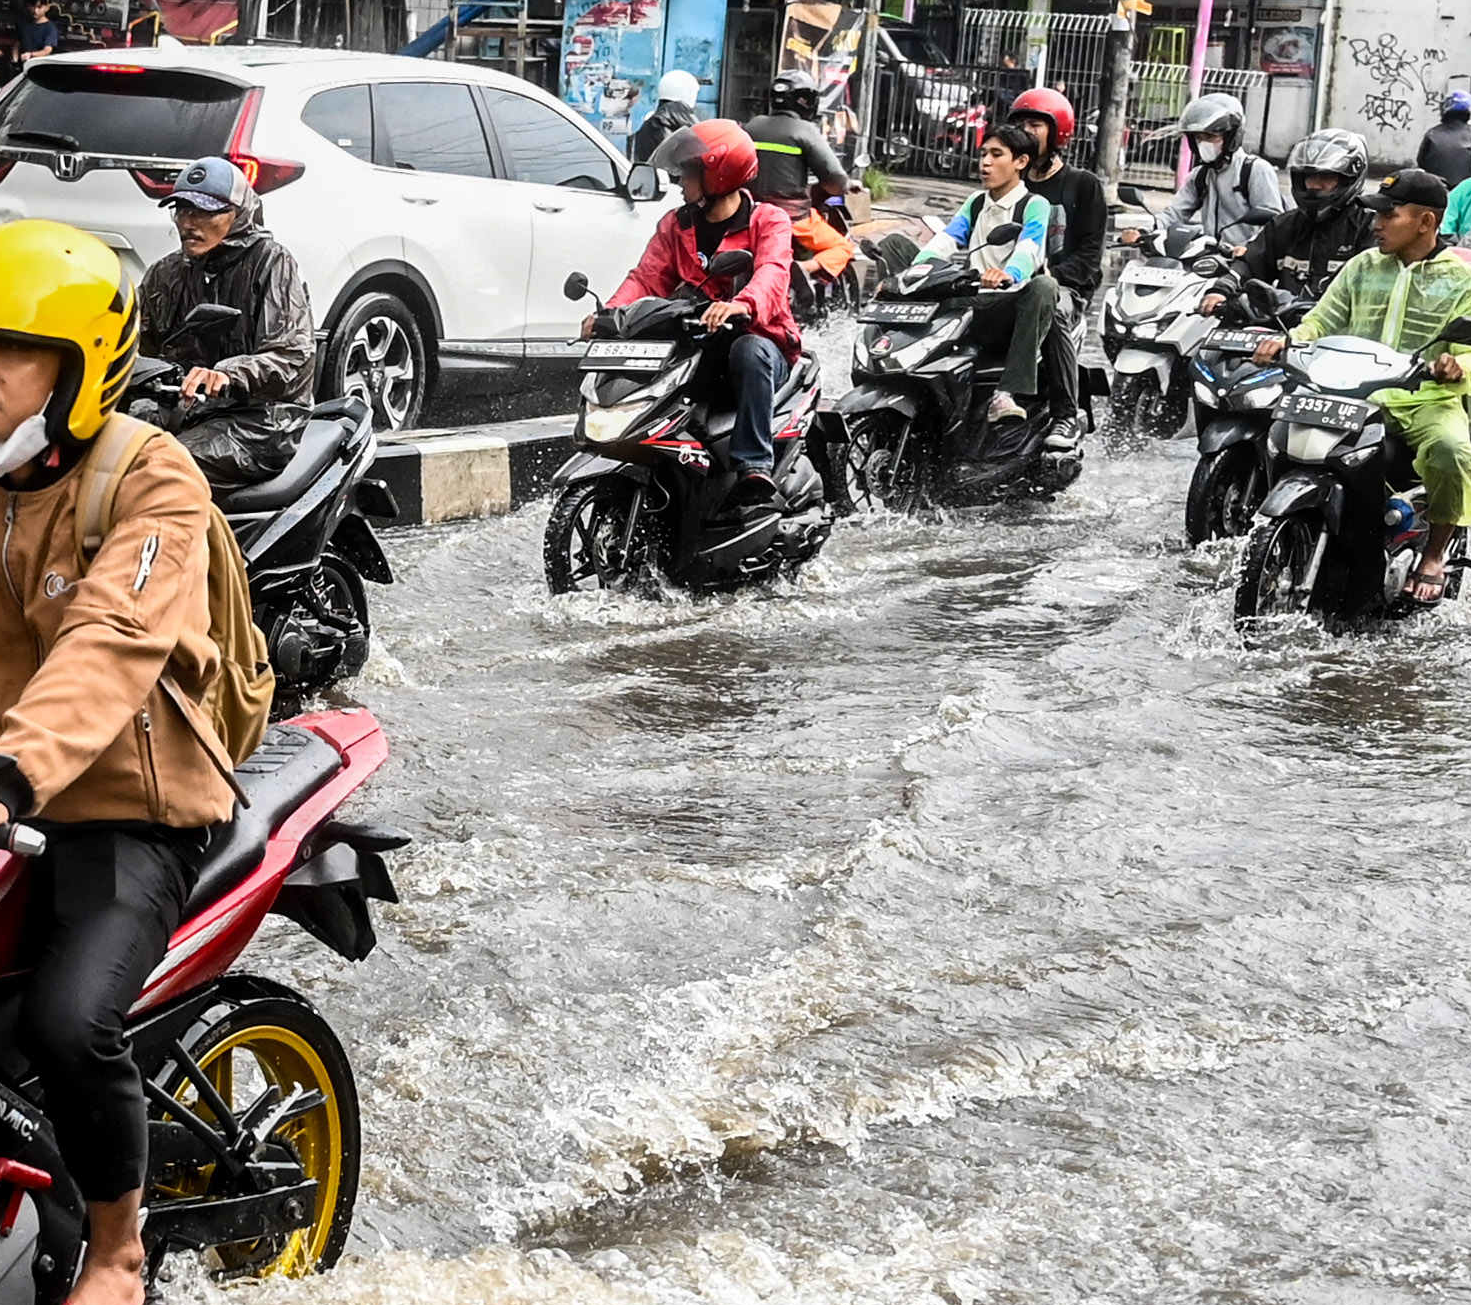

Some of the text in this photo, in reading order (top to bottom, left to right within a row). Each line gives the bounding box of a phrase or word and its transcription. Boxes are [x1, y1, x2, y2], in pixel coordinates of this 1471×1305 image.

[1280, 397, 1359, 417] E 3357 UF
